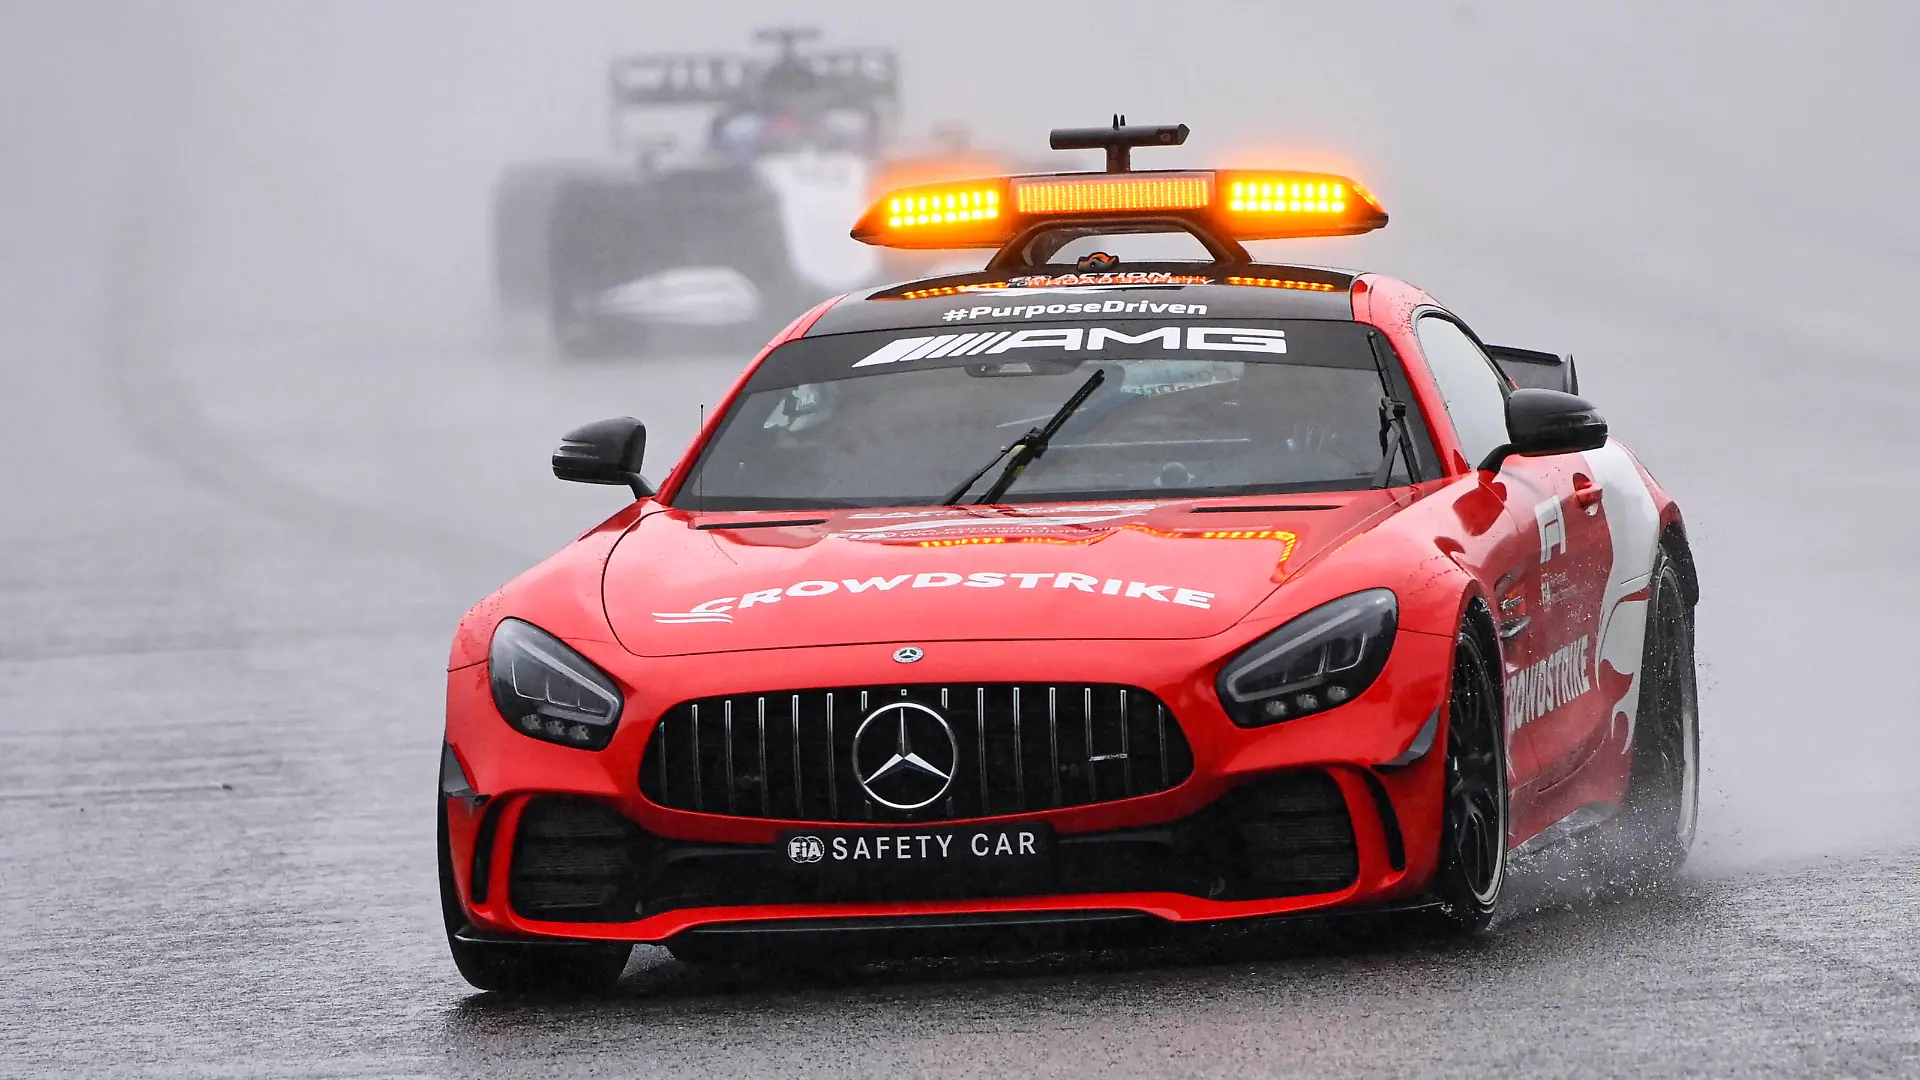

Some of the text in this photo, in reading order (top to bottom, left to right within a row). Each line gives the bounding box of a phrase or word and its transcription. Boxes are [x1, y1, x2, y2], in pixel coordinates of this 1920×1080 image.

[942, 299, 1209, 322] #PurposeDriven
[985, 326, 1288, 354] AMG
[652, 571, 1216, 624] CROWDSTRIKE
[832, 834, 953, 861] SAFETY
[970, 831, 1036, 857] CAR
